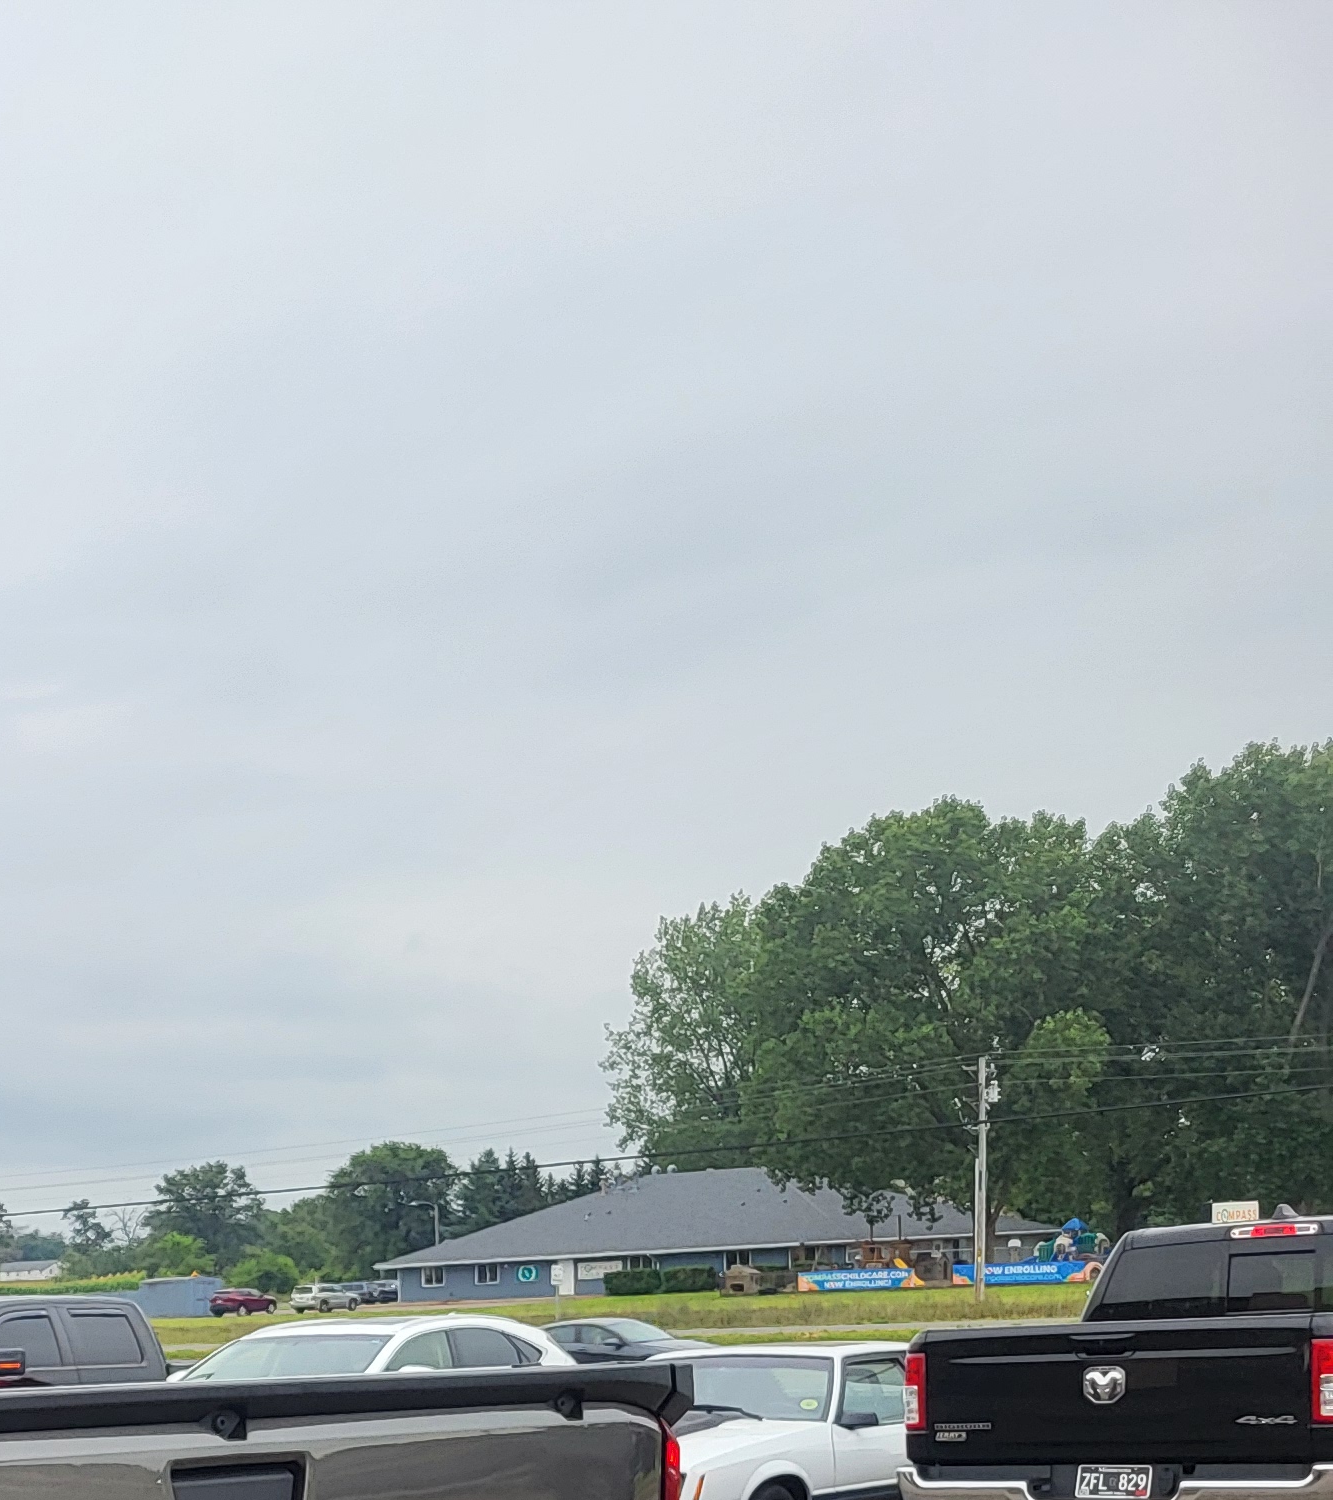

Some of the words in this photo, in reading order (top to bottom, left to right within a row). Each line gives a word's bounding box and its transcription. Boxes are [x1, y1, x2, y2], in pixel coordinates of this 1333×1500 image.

[1216, 1208, 1258, 1222] COMPASS
[982, 1264, 1003, 1275] OW
[1004, 1264, 1058, 1274] ENROLLING
[1081, 1473, 1108, 1490] ZFL
[1118, 1473, 1147, 1491] 829
